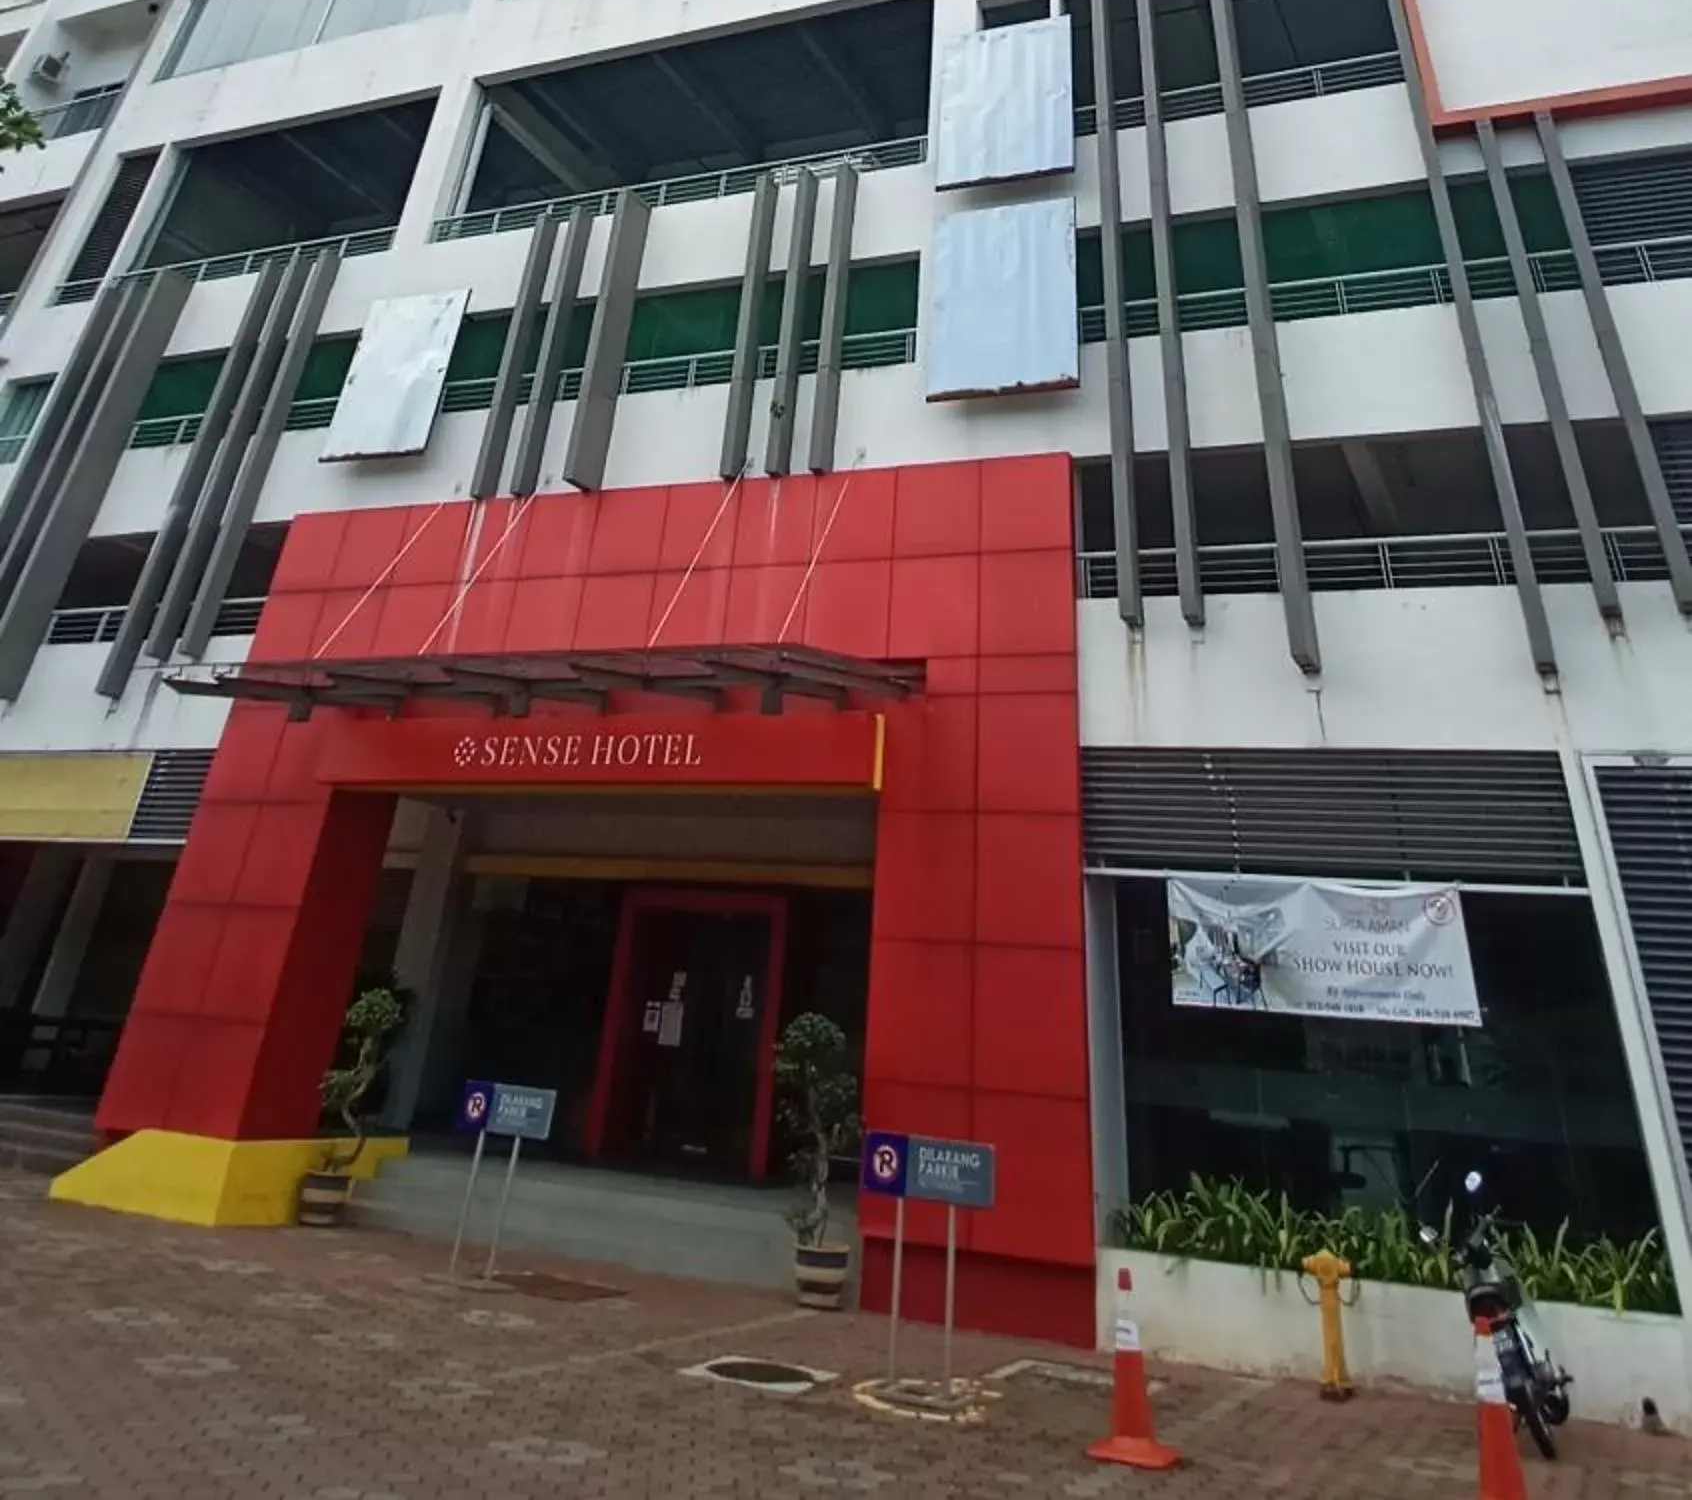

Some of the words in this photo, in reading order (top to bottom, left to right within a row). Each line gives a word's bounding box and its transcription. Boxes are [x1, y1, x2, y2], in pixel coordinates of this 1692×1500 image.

[480, 735, 582, 767] SENSE
[591, 733, 701, 766] HOTEL
[1333, 941, 1370, 955] VISIT
[1374, 942, 1407, 957] OUR
[1293, 957, 1342, 973] SHOW
[1347, 959, 1404, 977] HOUSE
[1408, 963, 1453, 979] NOW!
